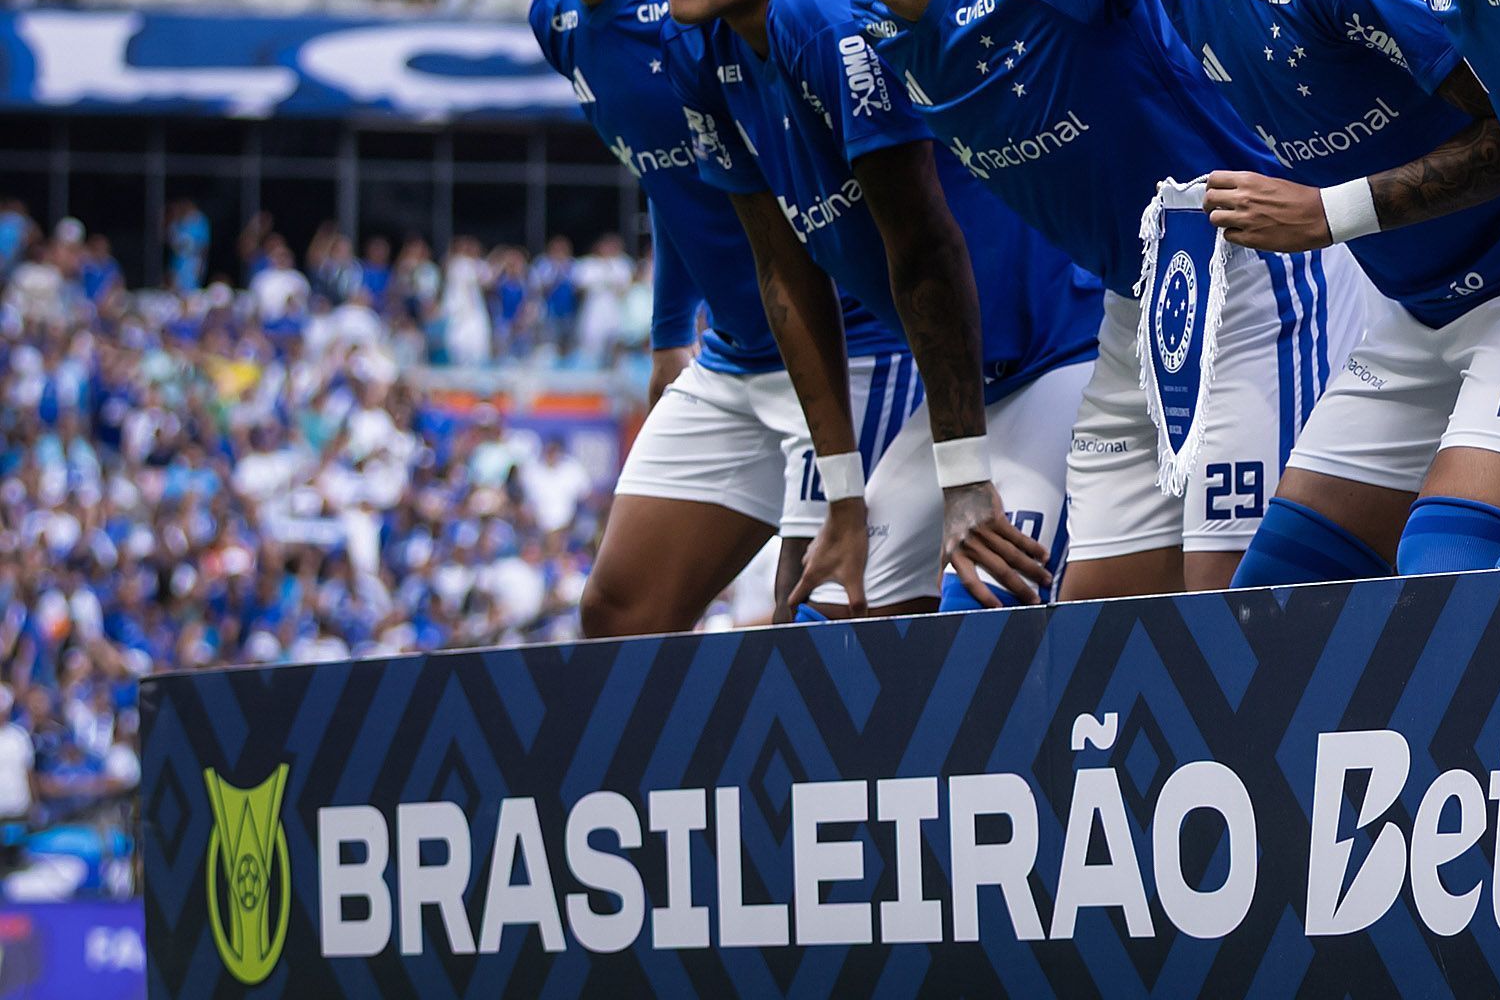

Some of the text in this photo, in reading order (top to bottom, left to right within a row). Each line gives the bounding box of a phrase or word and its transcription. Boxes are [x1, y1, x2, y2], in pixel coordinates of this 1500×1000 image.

[839, 34, 876, 92] OMO
[1369, 30, 1414, 76] OM
[975, 110, 1089, 170] nacional
[1281, 97, 1399, 161] nacional
[1074, 438, 1129, 453] nacional
[1205, 461, 1265, 520] 29
[319, 712, 1258, 957] BRASILEIRÃO
